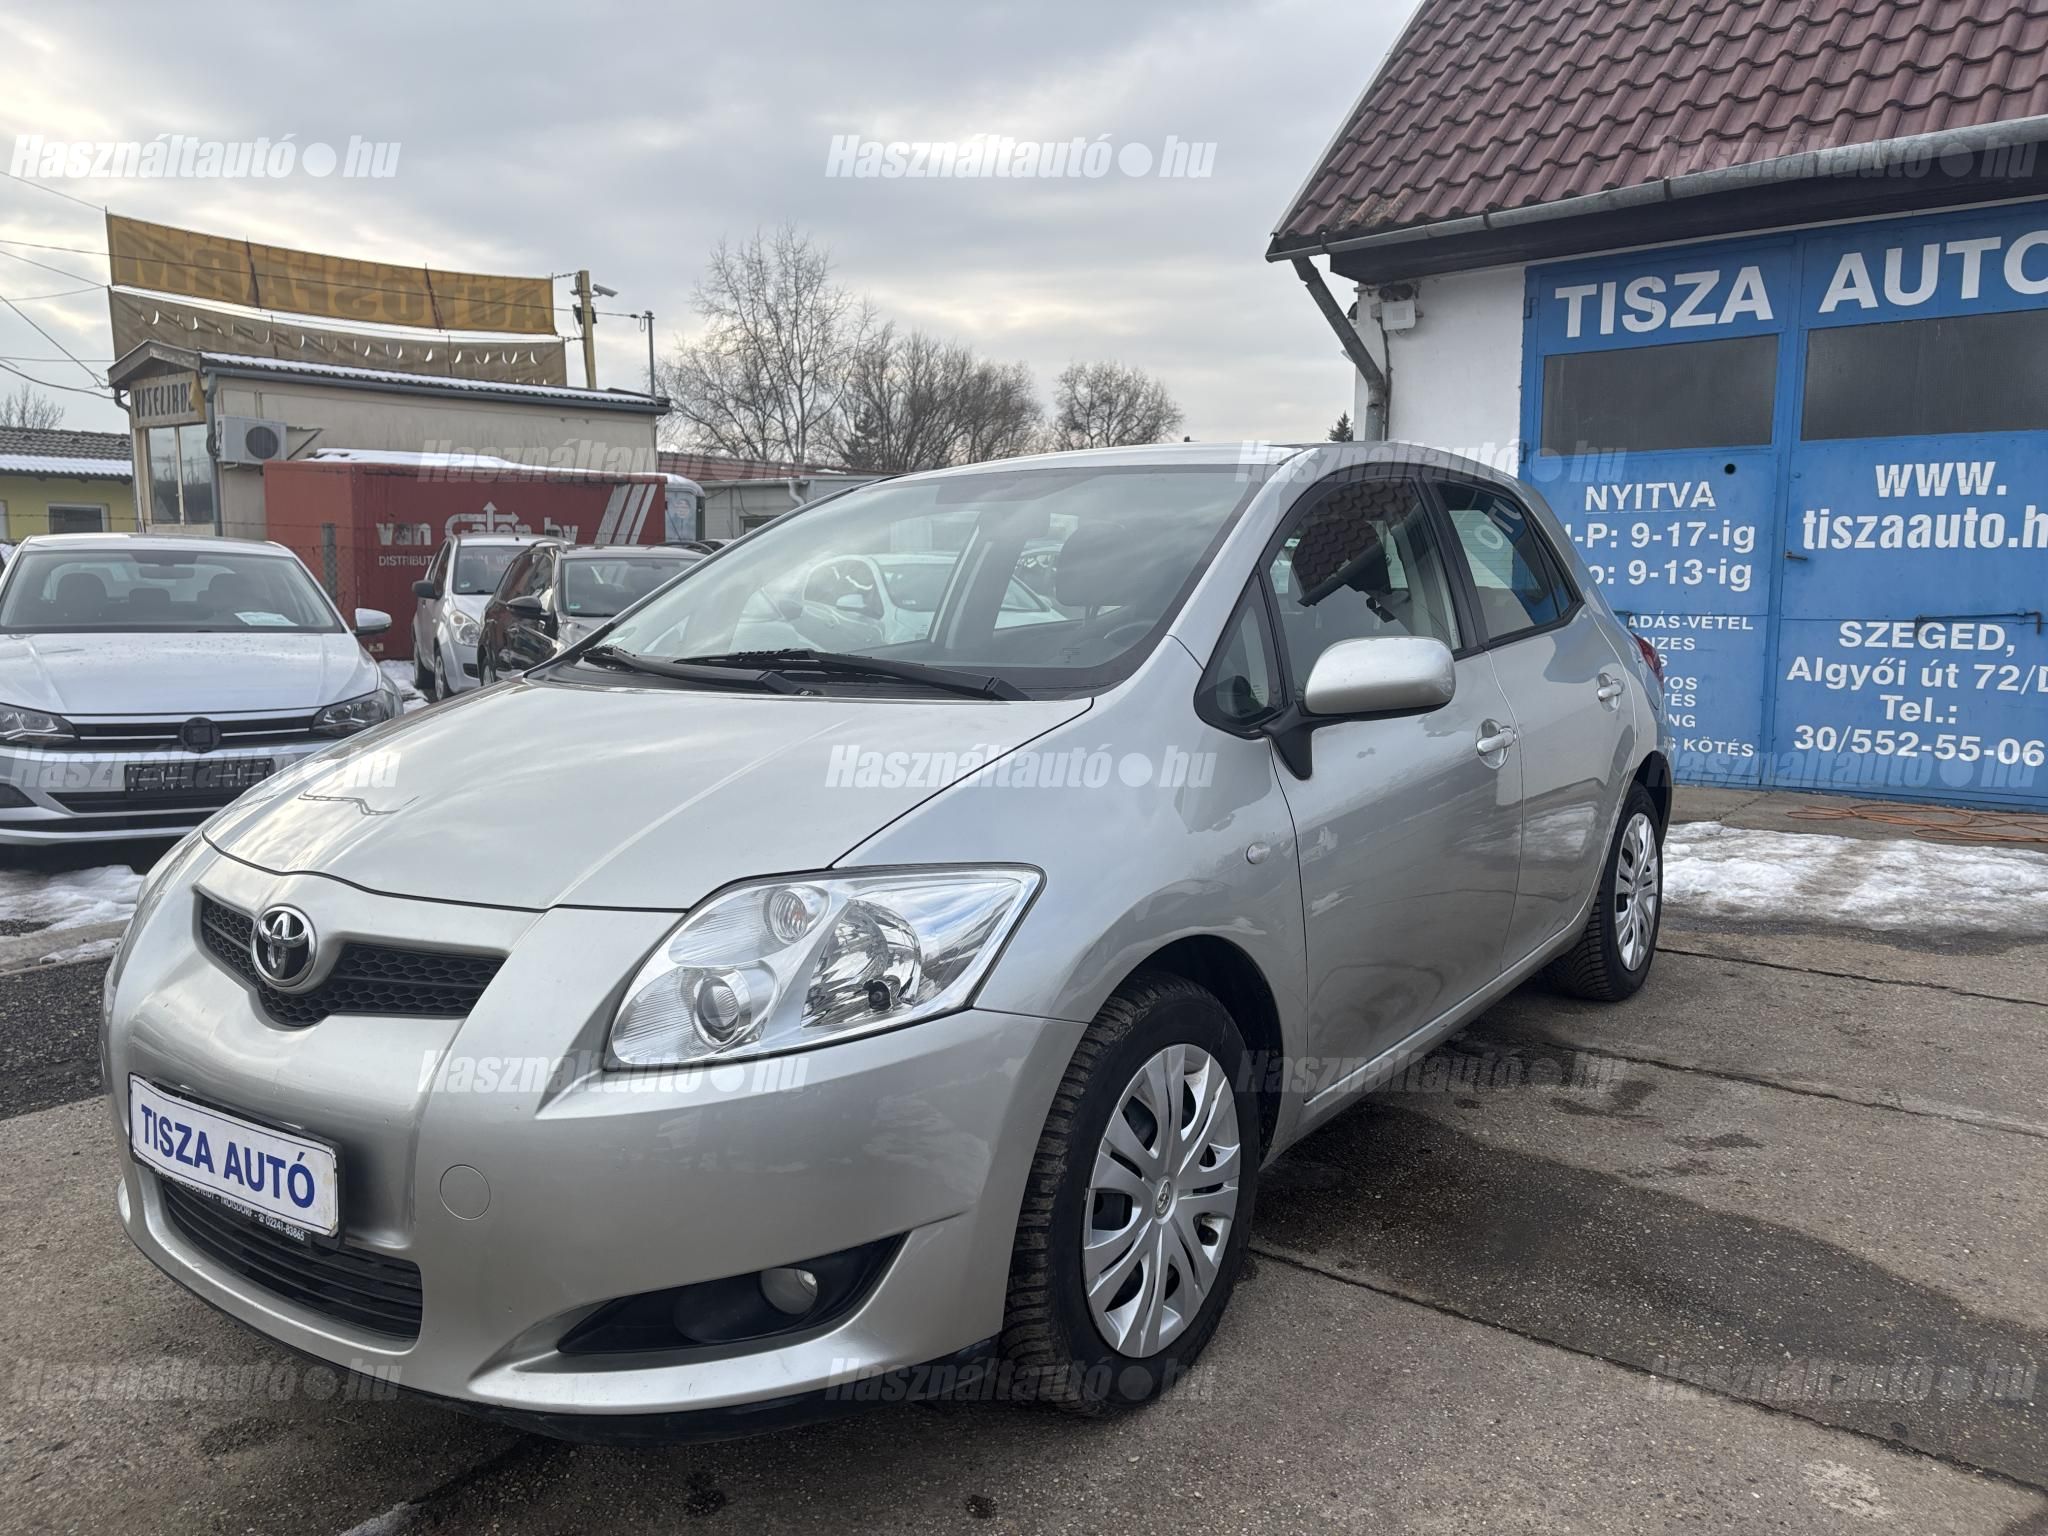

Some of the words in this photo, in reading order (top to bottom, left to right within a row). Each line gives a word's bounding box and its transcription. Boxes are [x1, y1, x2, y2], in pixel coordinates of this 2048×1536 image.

[1554, 265, 1774, 338] TISZA
[1585, 481, 1717, 512] NYITVA
[1875, 461, 2007, 497] www.
[1631, 519, 1756, 553] 9-17-ig
[1628, 558, 1753, 592] 9-13-ig
[1628, 610, 1754, 630] ADÁS-VÉTEL
[1838, 620, 2016, 657] SZEGED,
[1786, 655, 1906, 692] Algyői
[1921, 659, 1960, 689] út
[1879, 694, 1958, 725] Tel.:
[1684, 736, 1755, 757] KÖTÉS
[1793, 725, 2046, 767] 30/552-55-06
[141, 1104, 215, 1174] TISZA
[223, 1141, 316, 1209] AUTÓ
